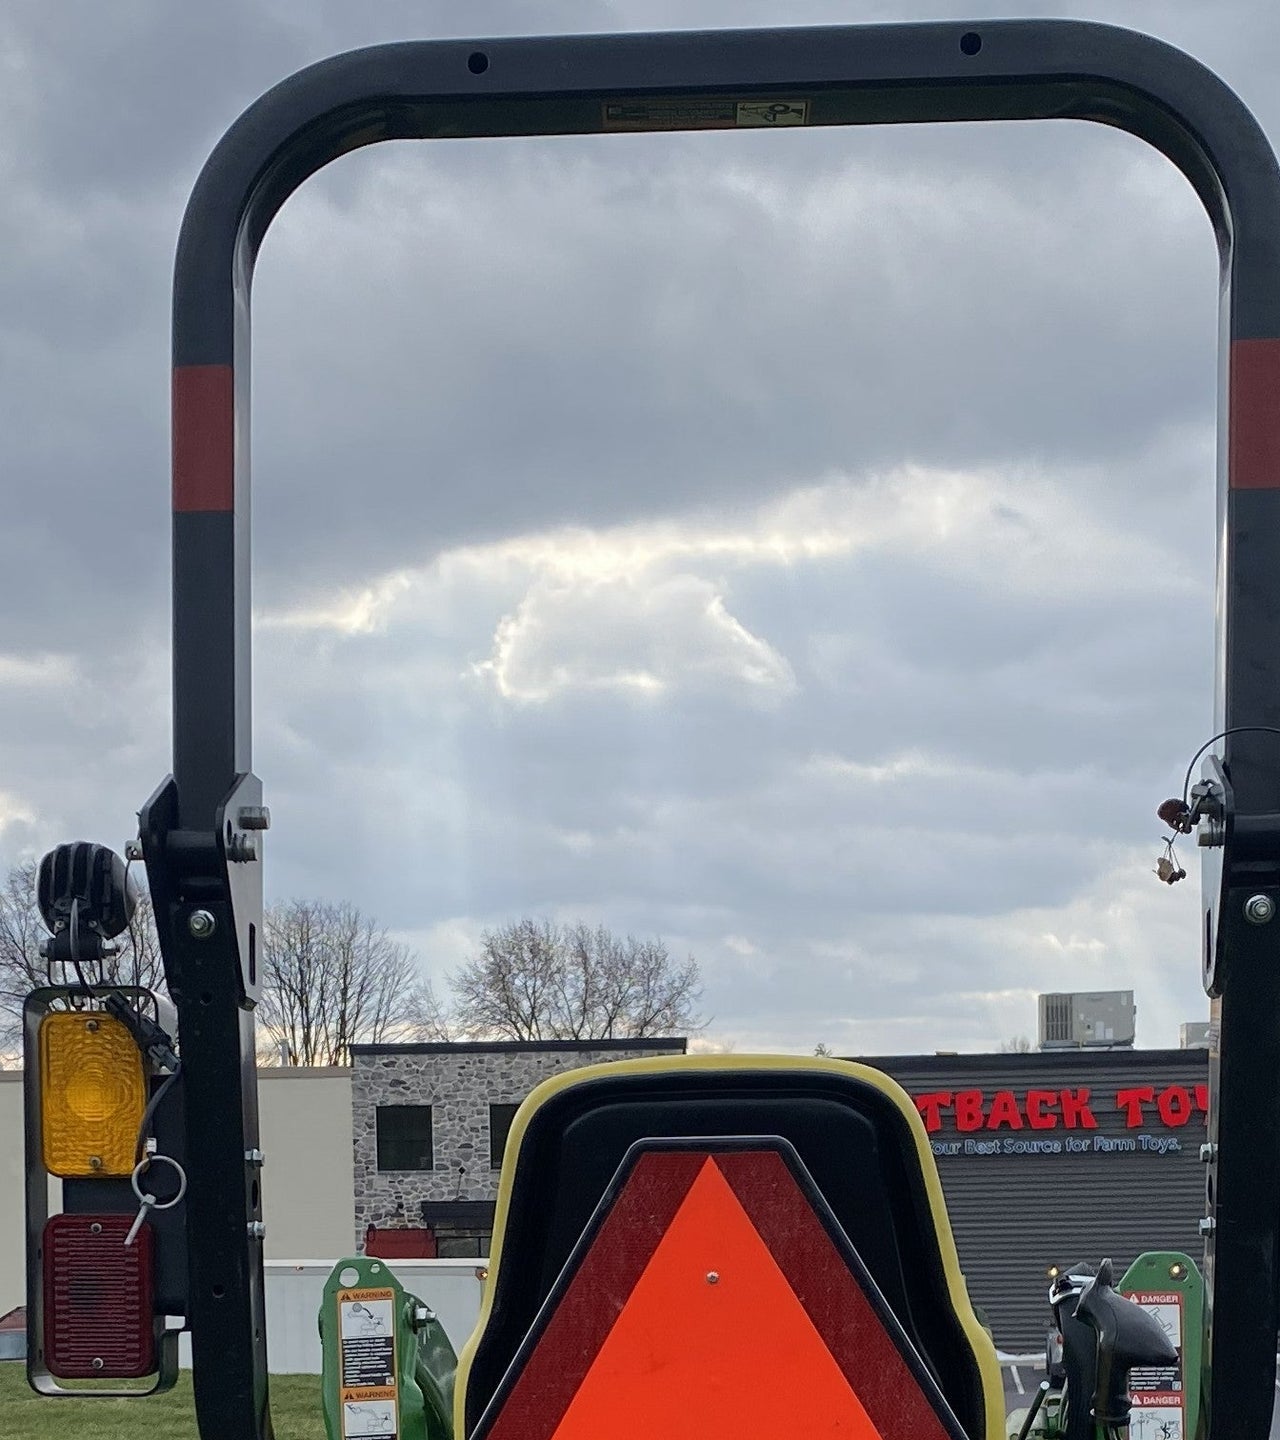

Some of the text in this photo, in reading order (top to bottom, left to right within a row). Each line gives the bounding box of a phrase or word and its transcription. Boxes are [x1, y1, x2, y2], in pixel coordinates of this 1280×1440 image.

[915, 1084, 1208, 1132] TBACK TO
[964, 1139, 1000, 1154] Best
[1004, 1138, 1061, 1153] Source
[1065, 1136, 1091, 1152] for
[1093, 1136, 1136, 1151] Farm
[1138, 1134, 1182, 1154] Toys.
[352, 1291, 392, 1300] WARNING
[1141, 1295, 1179, 1303] DANGER
[355, 1390, 395, 1398] WARNING
[1143, 1396, 1181, 1404] DANGER
